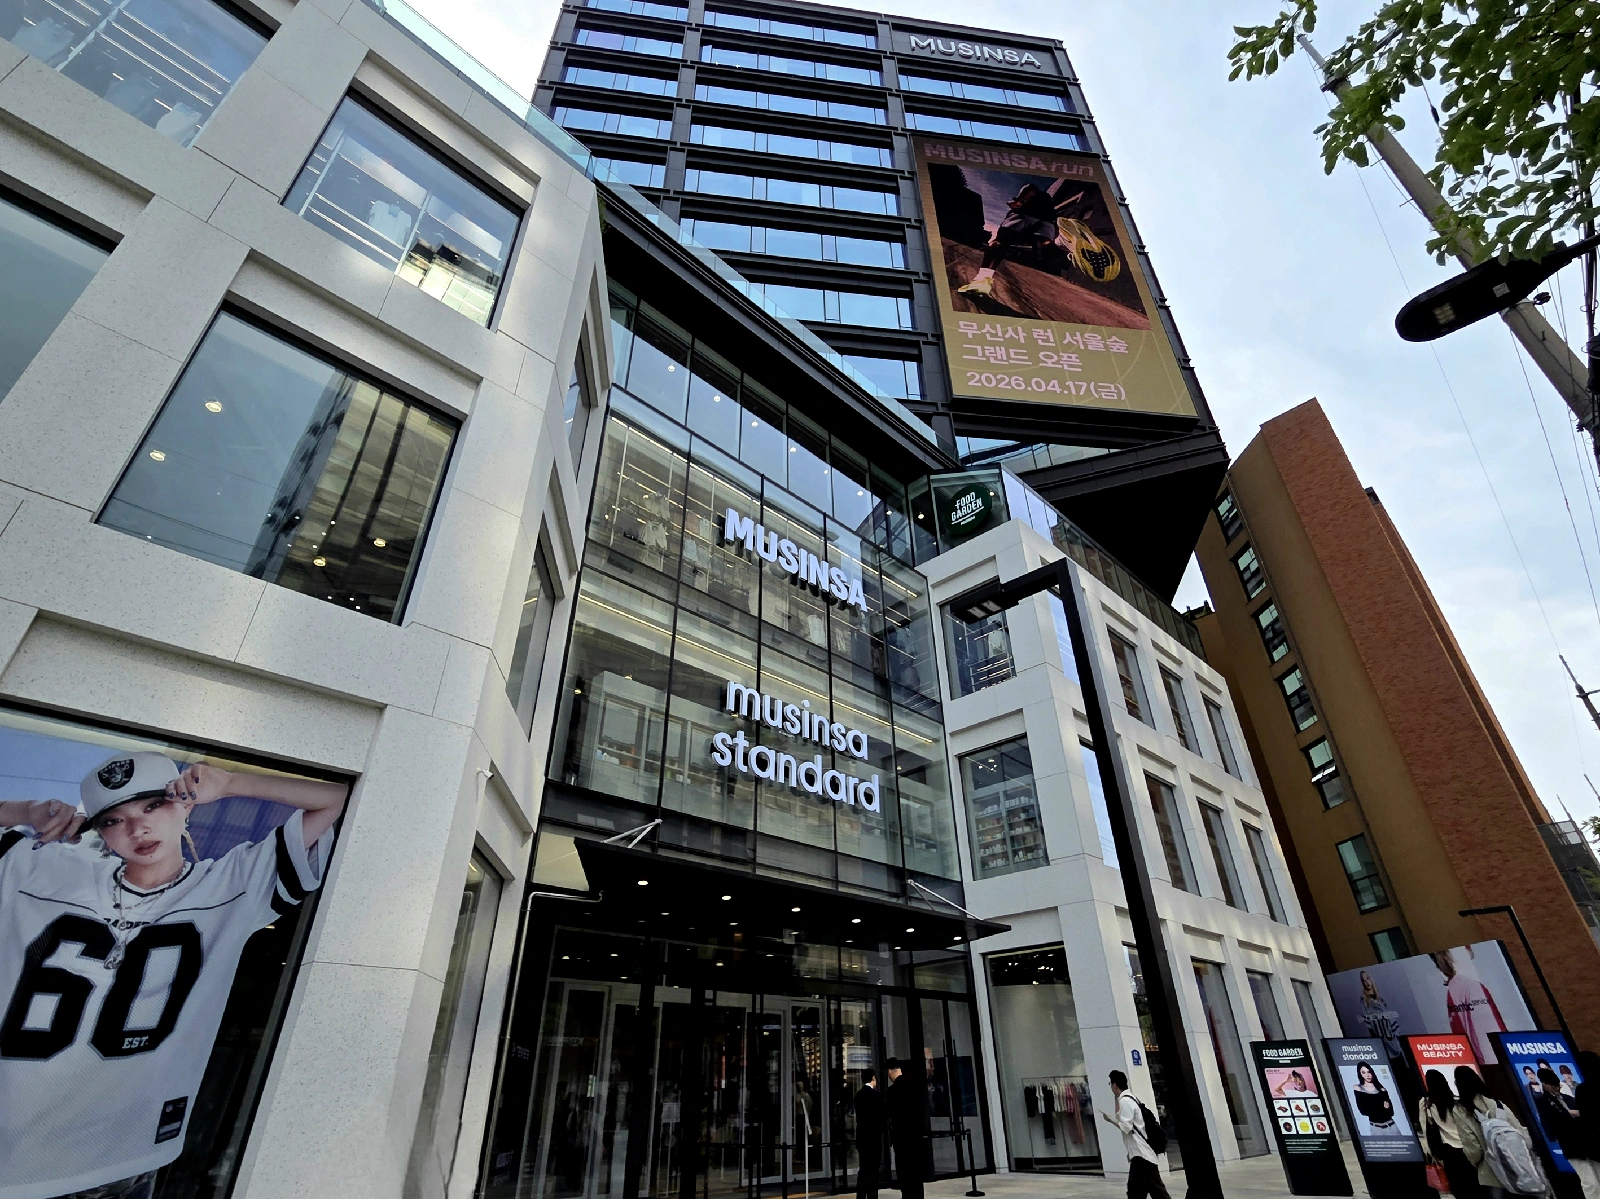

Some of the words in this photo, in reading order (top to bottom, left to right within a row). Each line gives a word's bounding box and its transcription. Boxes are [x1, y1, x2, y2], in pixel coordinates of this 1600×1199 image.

[909, 35, 1041, 69] MUSINSA
[924, 143, 1047, 172] MUSINSA
[1051, 161, 1094, 176] run
[957, 320, 1026, 344] 무신사
[1032, 327, 1056, 347] 런
[1062, 331, 1129, 354] 서울숲
[962, 344, 1032, 366] 그랜드
[1039, 350, 1082, 372] 오픈
[966, 371, 1126, 401] 2026.04.17(금)
[951, 497, 983, 522] GARDEN
[955, 491, 976, 509] FOOD
[725, 507, 867, 612] MUSINSA
[726, 680, 868, 760] musinsa
[711, 730, 880, 813] standard
[0, 911, 204, 1061] 60
[121, 1036, 149, 1049] EST.
[1262, 1049, 1278, 1057] FOOD
[1279, 1047, 1304, 1057] GARDEN
[1343, 1052, 1378, 1060] standard
[1416, 1043, 1465, 1051] MUSINSA
[1506, 1042, 1567, 1054] MUSINSA
